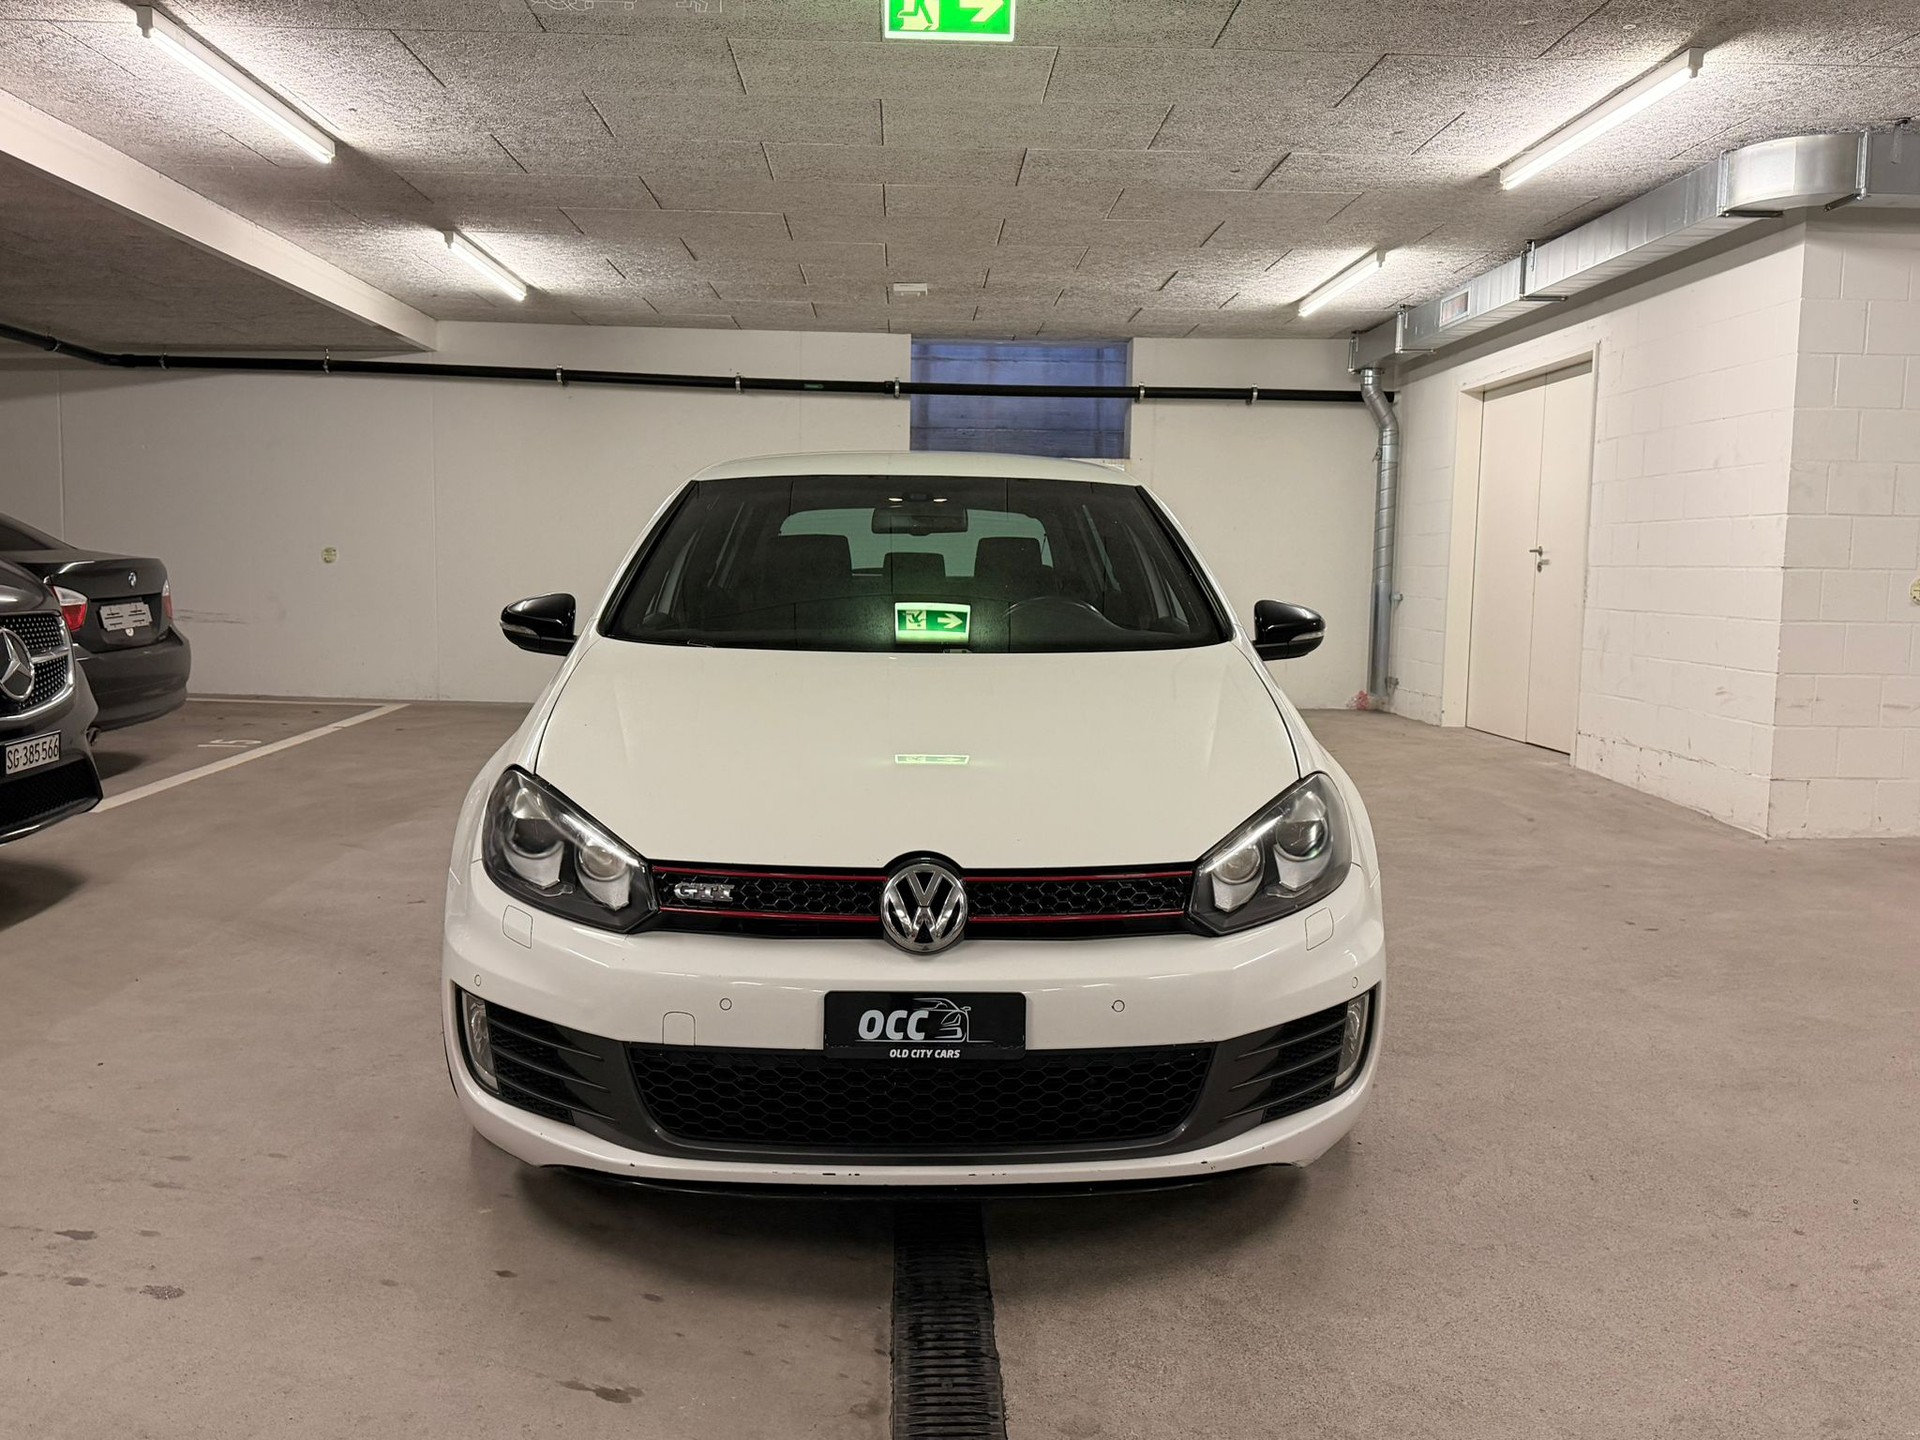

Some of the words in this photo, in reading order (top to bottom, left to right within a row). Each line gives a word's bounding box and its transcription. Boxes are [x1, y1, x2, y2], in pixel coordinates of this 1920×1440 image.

[674, 882, 735, 901] GTI
[858, 1009, 929, 1040] OCC
[889, 1048, 909, 1059] OLD
[910, 1048, 935, 1059] CITY
[934, 1048, 961, 1059] CARS
